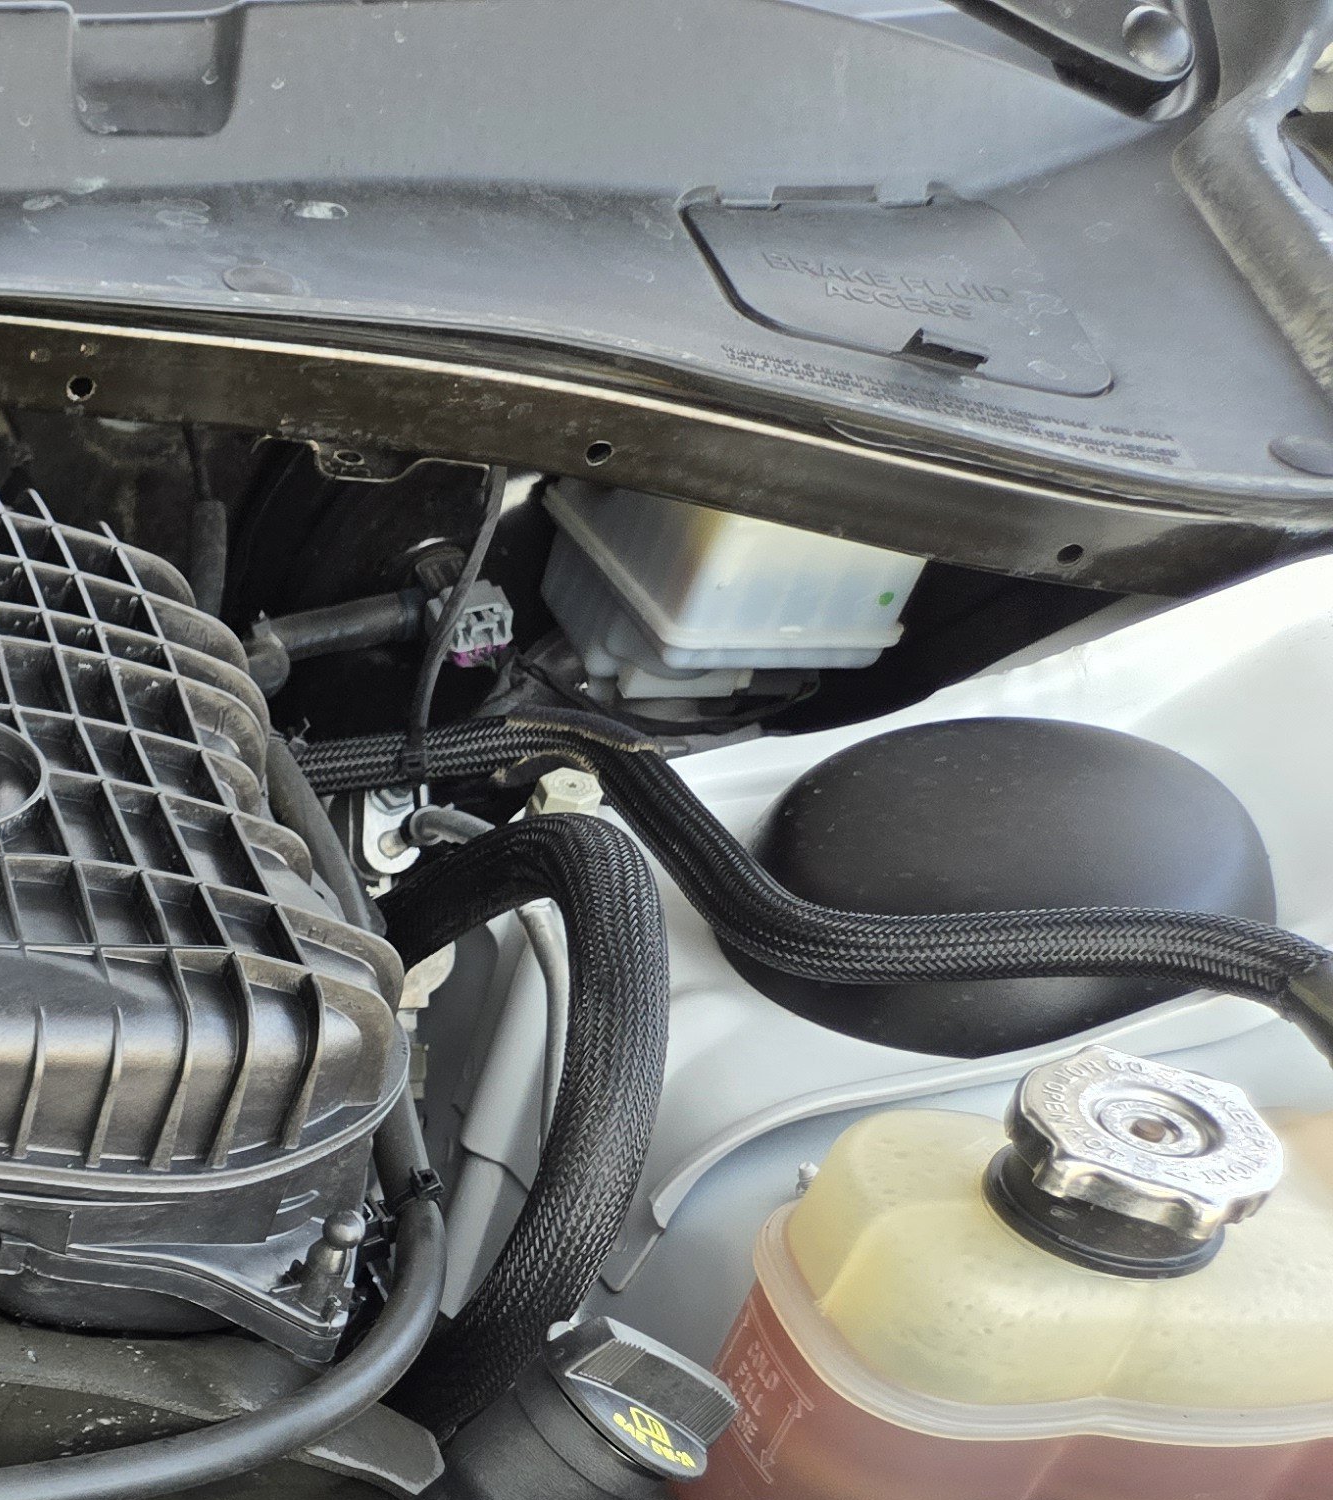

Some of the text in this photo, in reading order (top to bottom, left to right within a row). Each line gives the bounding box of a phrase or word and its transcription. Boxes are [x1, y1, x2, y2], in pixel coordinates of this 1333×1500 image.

[762, 252, 1012, 304] BRAKE FLUID
[825, 280, 974, 320] ACCESS
[1054, 1059, 1102, 1085] NOT
[1041, 1081, 1077, 1125] OPEN
[1064, 1124, 1126, 1162] HOT
